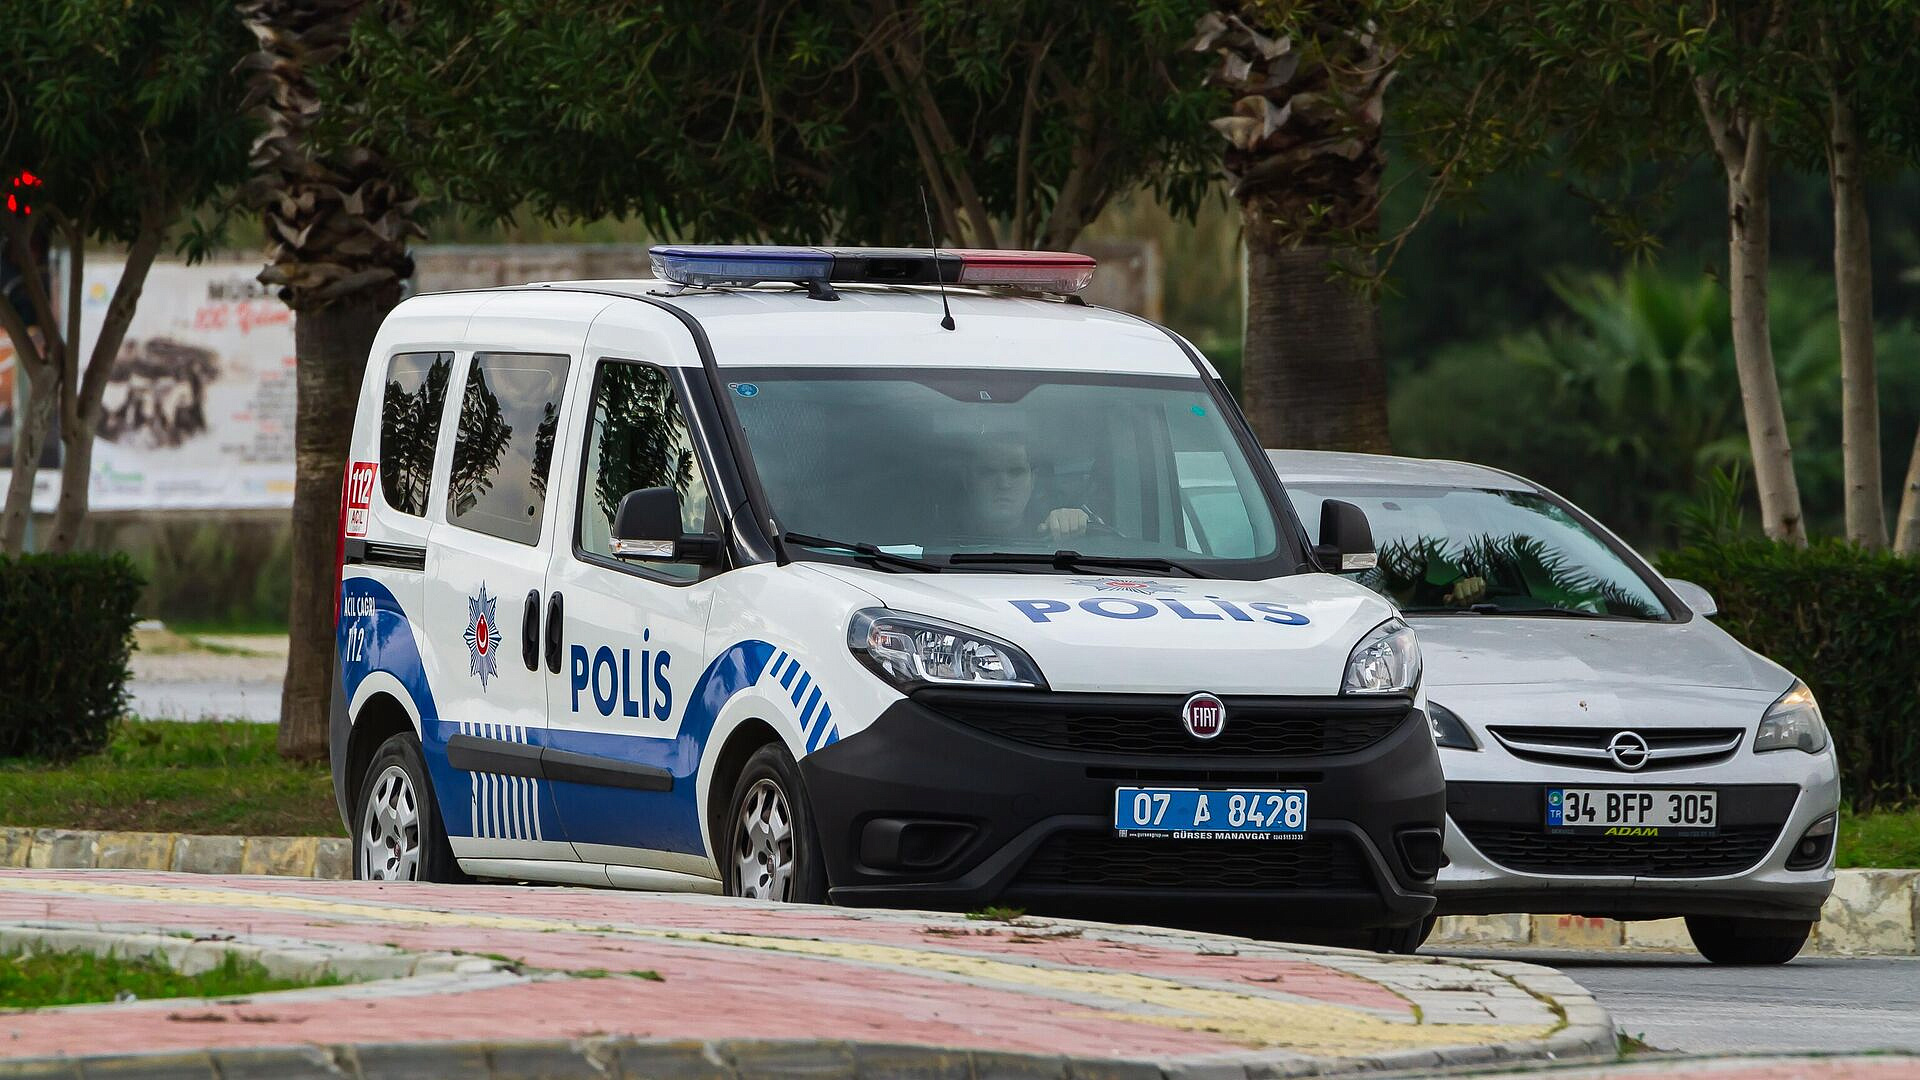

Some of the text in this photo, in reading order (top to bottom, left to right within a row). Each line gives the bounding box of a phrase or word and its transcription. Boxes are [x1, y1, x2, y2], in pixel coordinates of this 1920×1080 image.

[352, 469, 373, 504] 112
[1008, 595, 1311, 626] POLİS
[346, 627, 365, 662] 112
[570, 627, 673, 722] POLİS
[1193, 707, 1218, 727] FIAT
[1133, 793, 1302, 828] 07 A 8428
[1550, 810, 1562, 818] TR
[1565, 792, 1714, 825] 34 BFP 305
[1173, 830, 1213, 840] GÜRSES
[1215, 832, 1271, 840] MANAVGAT
[1604, 827, 1659, 837] ADAM
